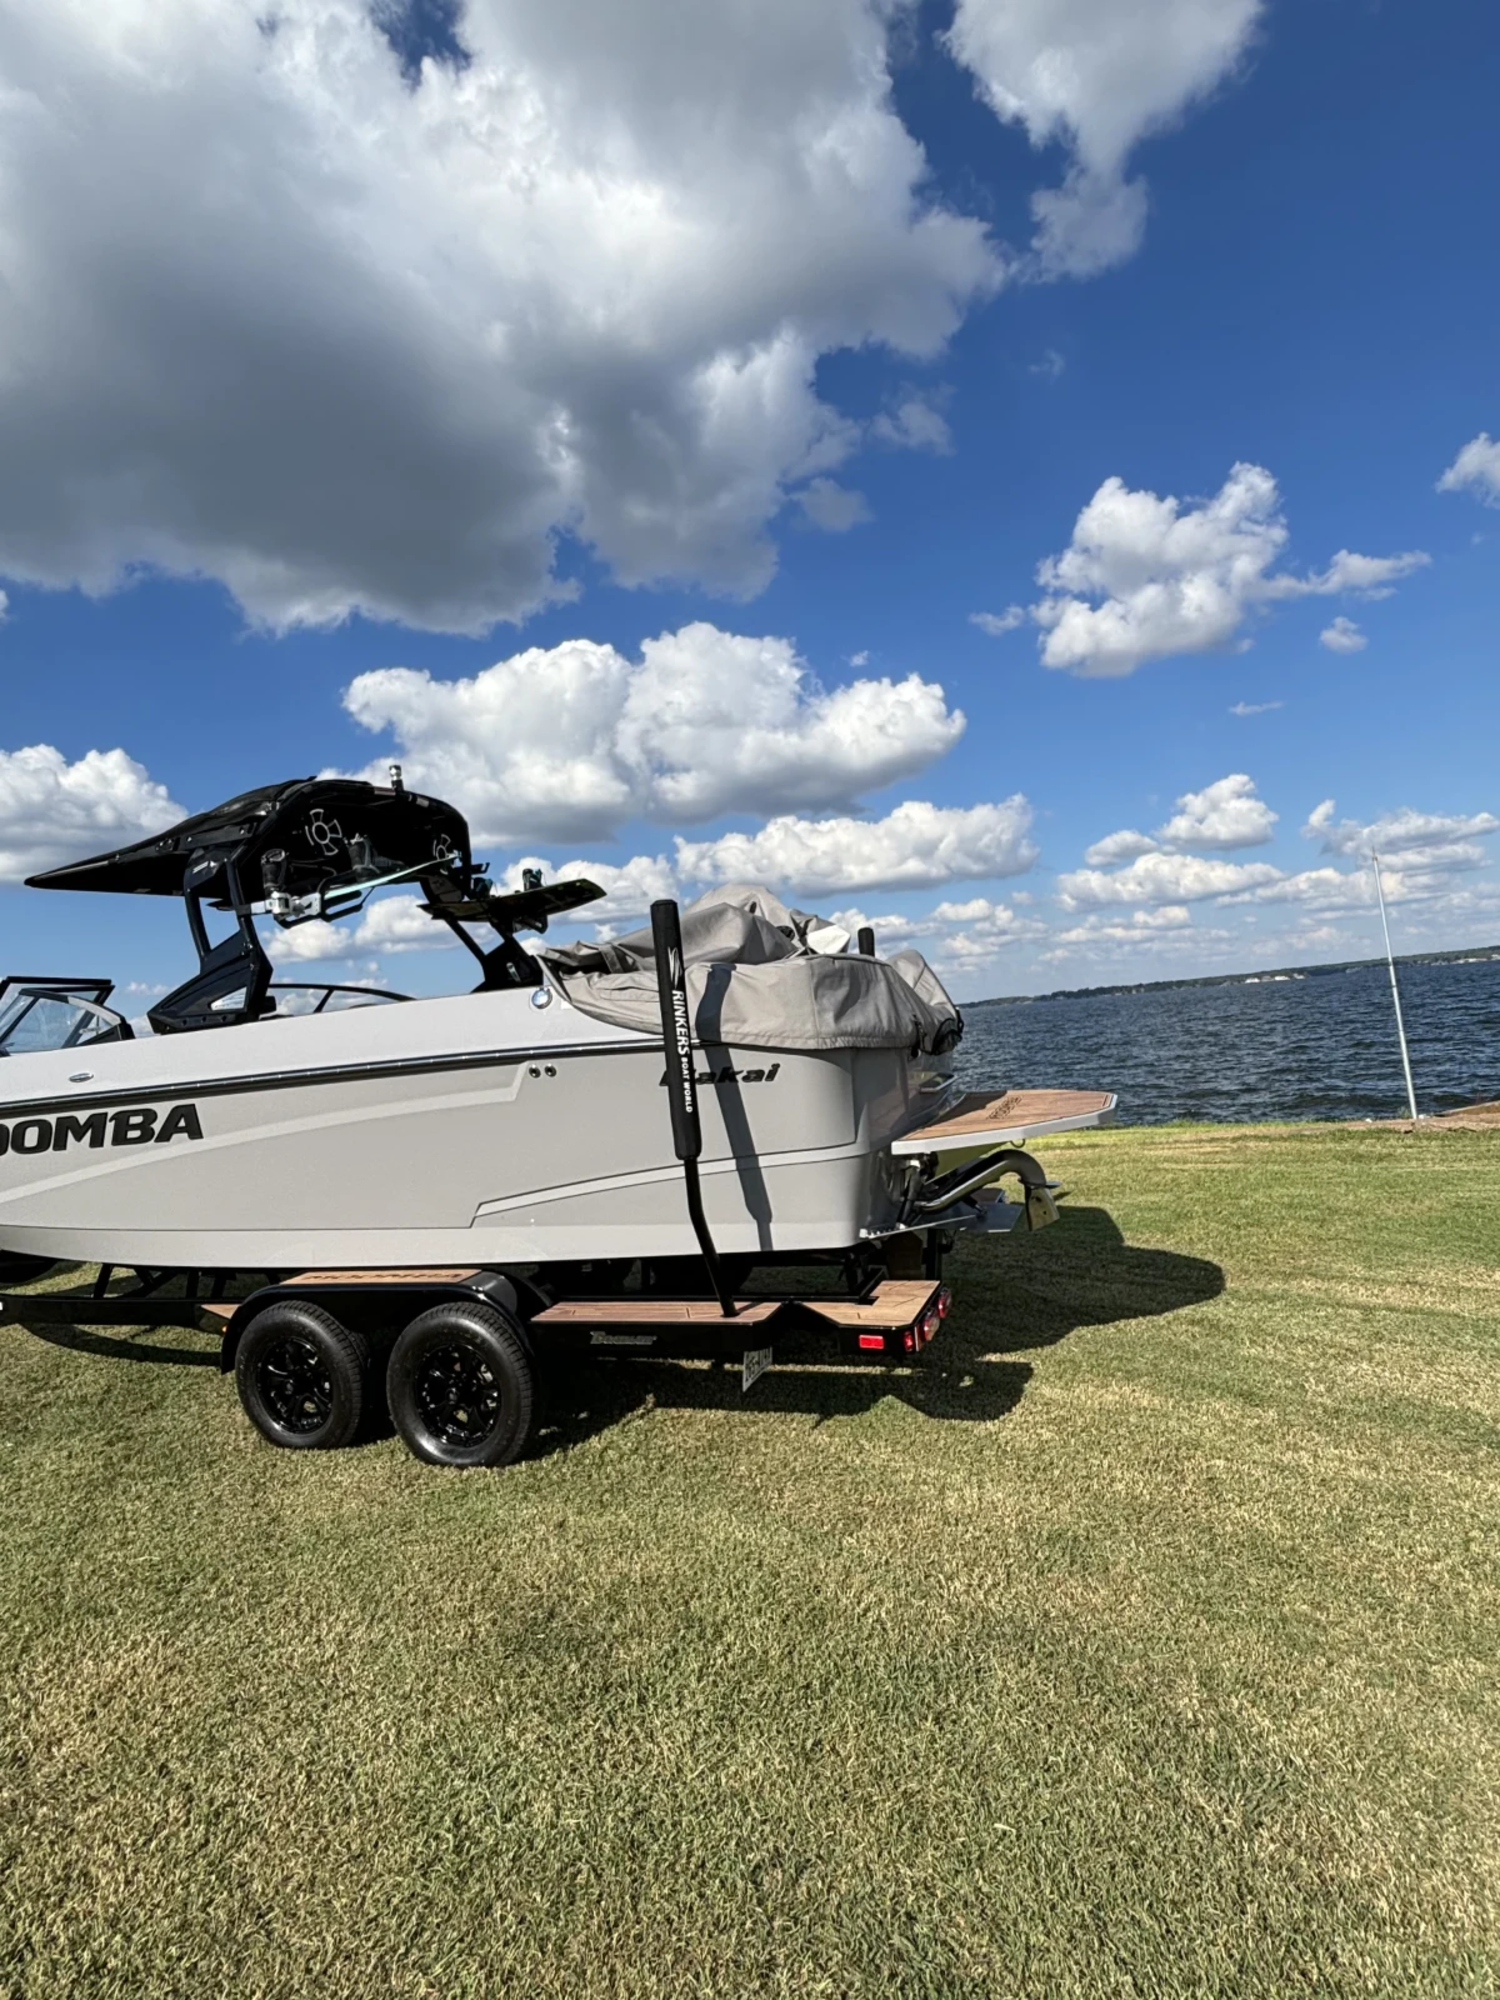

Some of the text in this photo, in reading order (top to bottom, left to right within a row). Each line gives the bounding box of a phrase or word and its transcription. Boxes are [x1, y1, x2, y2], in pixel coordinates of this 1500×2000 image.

[658, 1062, 781, 1087] akai
[672, 990, 693, 1113] RINKERS BOAT WORLD
[0, 1103, 204, 1157] OMBA
